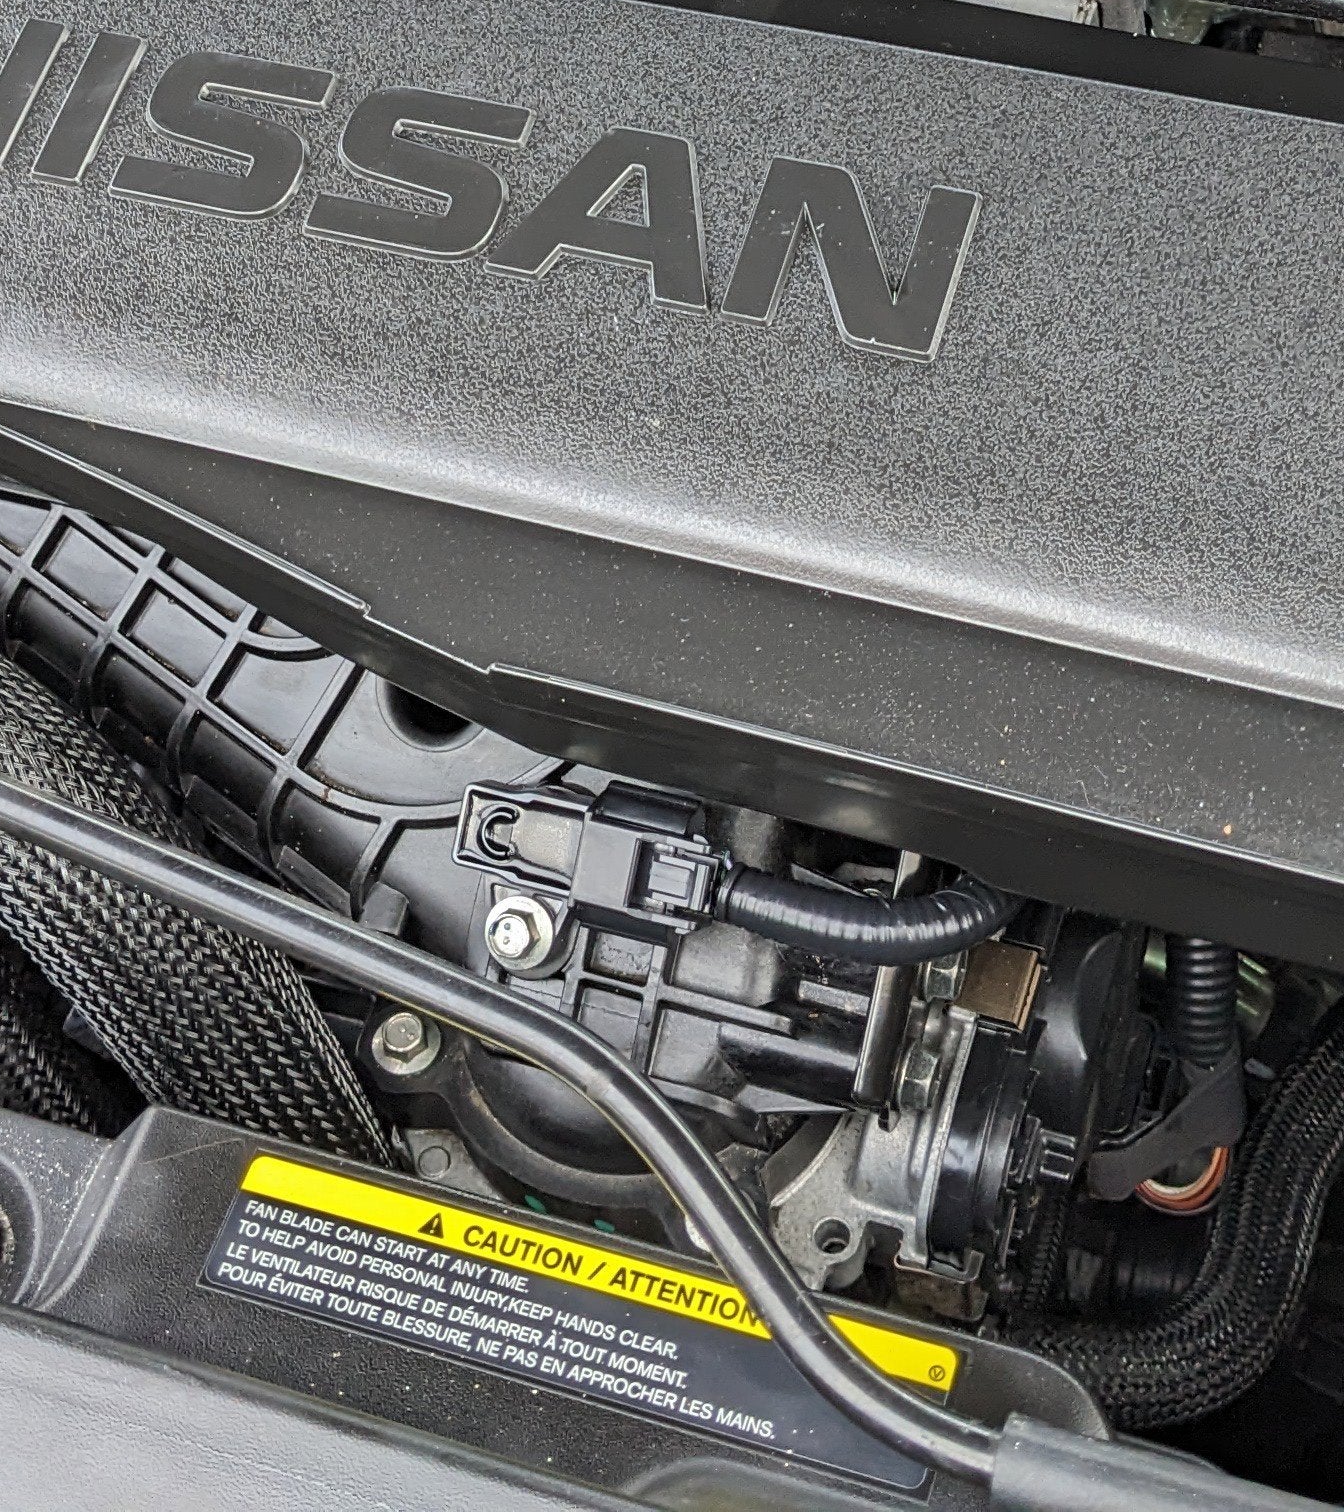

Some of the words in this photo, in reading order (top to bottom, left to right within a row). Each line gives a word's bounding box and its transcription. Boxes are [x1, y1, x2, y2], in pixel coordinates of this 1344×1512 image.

[225, 1241, 250, 1261] LE
[250, 1247, 357, 1293] VENTILATEUR
[356, 1278, 422, 1311] RISQUE
[422, 1298, 448, 1319] DE
[448, 1305, 543, 1347] DÉMARRER
[561, 1338, 608, 1365] TOUT
[608, 1351, 689, 1390] MOMENT.
[237, 1218, 261, 1238] TO
[261, 1226, 307, 1251] HELP
[306, 1240, 358, 1267] AVOID
[358, 1255, 447, 1294] PERSONAL
[554, 1310, 617, 1341] HANDS
[618, 1329, 679, 1361] CLEAR.
[245, 1199, 278, 1222] FAN
[279, 1208, 335, 1238] BLADE
[335, 1225, 372, 1249] CAN
[373, 1236, 428, 1264] START
[426, 1251, 451, 1270] AT
[449, 1260, 489, 1280] ANY
[489, 1268, 530, 1294] TIME.
[463, 1224, 584, 1276] CAUTION
[588, 1261, 607, 1281] /
[608, 1266, 758, 1328] ATTENTION
[217, 1261, 267, 1289] POUR
[268, 1272, 325, 1306] ÉVITER
[327, 1292, 382, 1323] TOUTE
[381, 1309, 474, 1353] BLESSURE,
[475, 1336, 504, 1358] NE
[503, 1345, 539, 1369] PAS
[539, 1355, 567, 1377] EN
[566, 1364, 679, 1411] APPROCHER
[678, 1396, 714, 1420] LES
[715, 1407, 776, 1440] MAINS.
